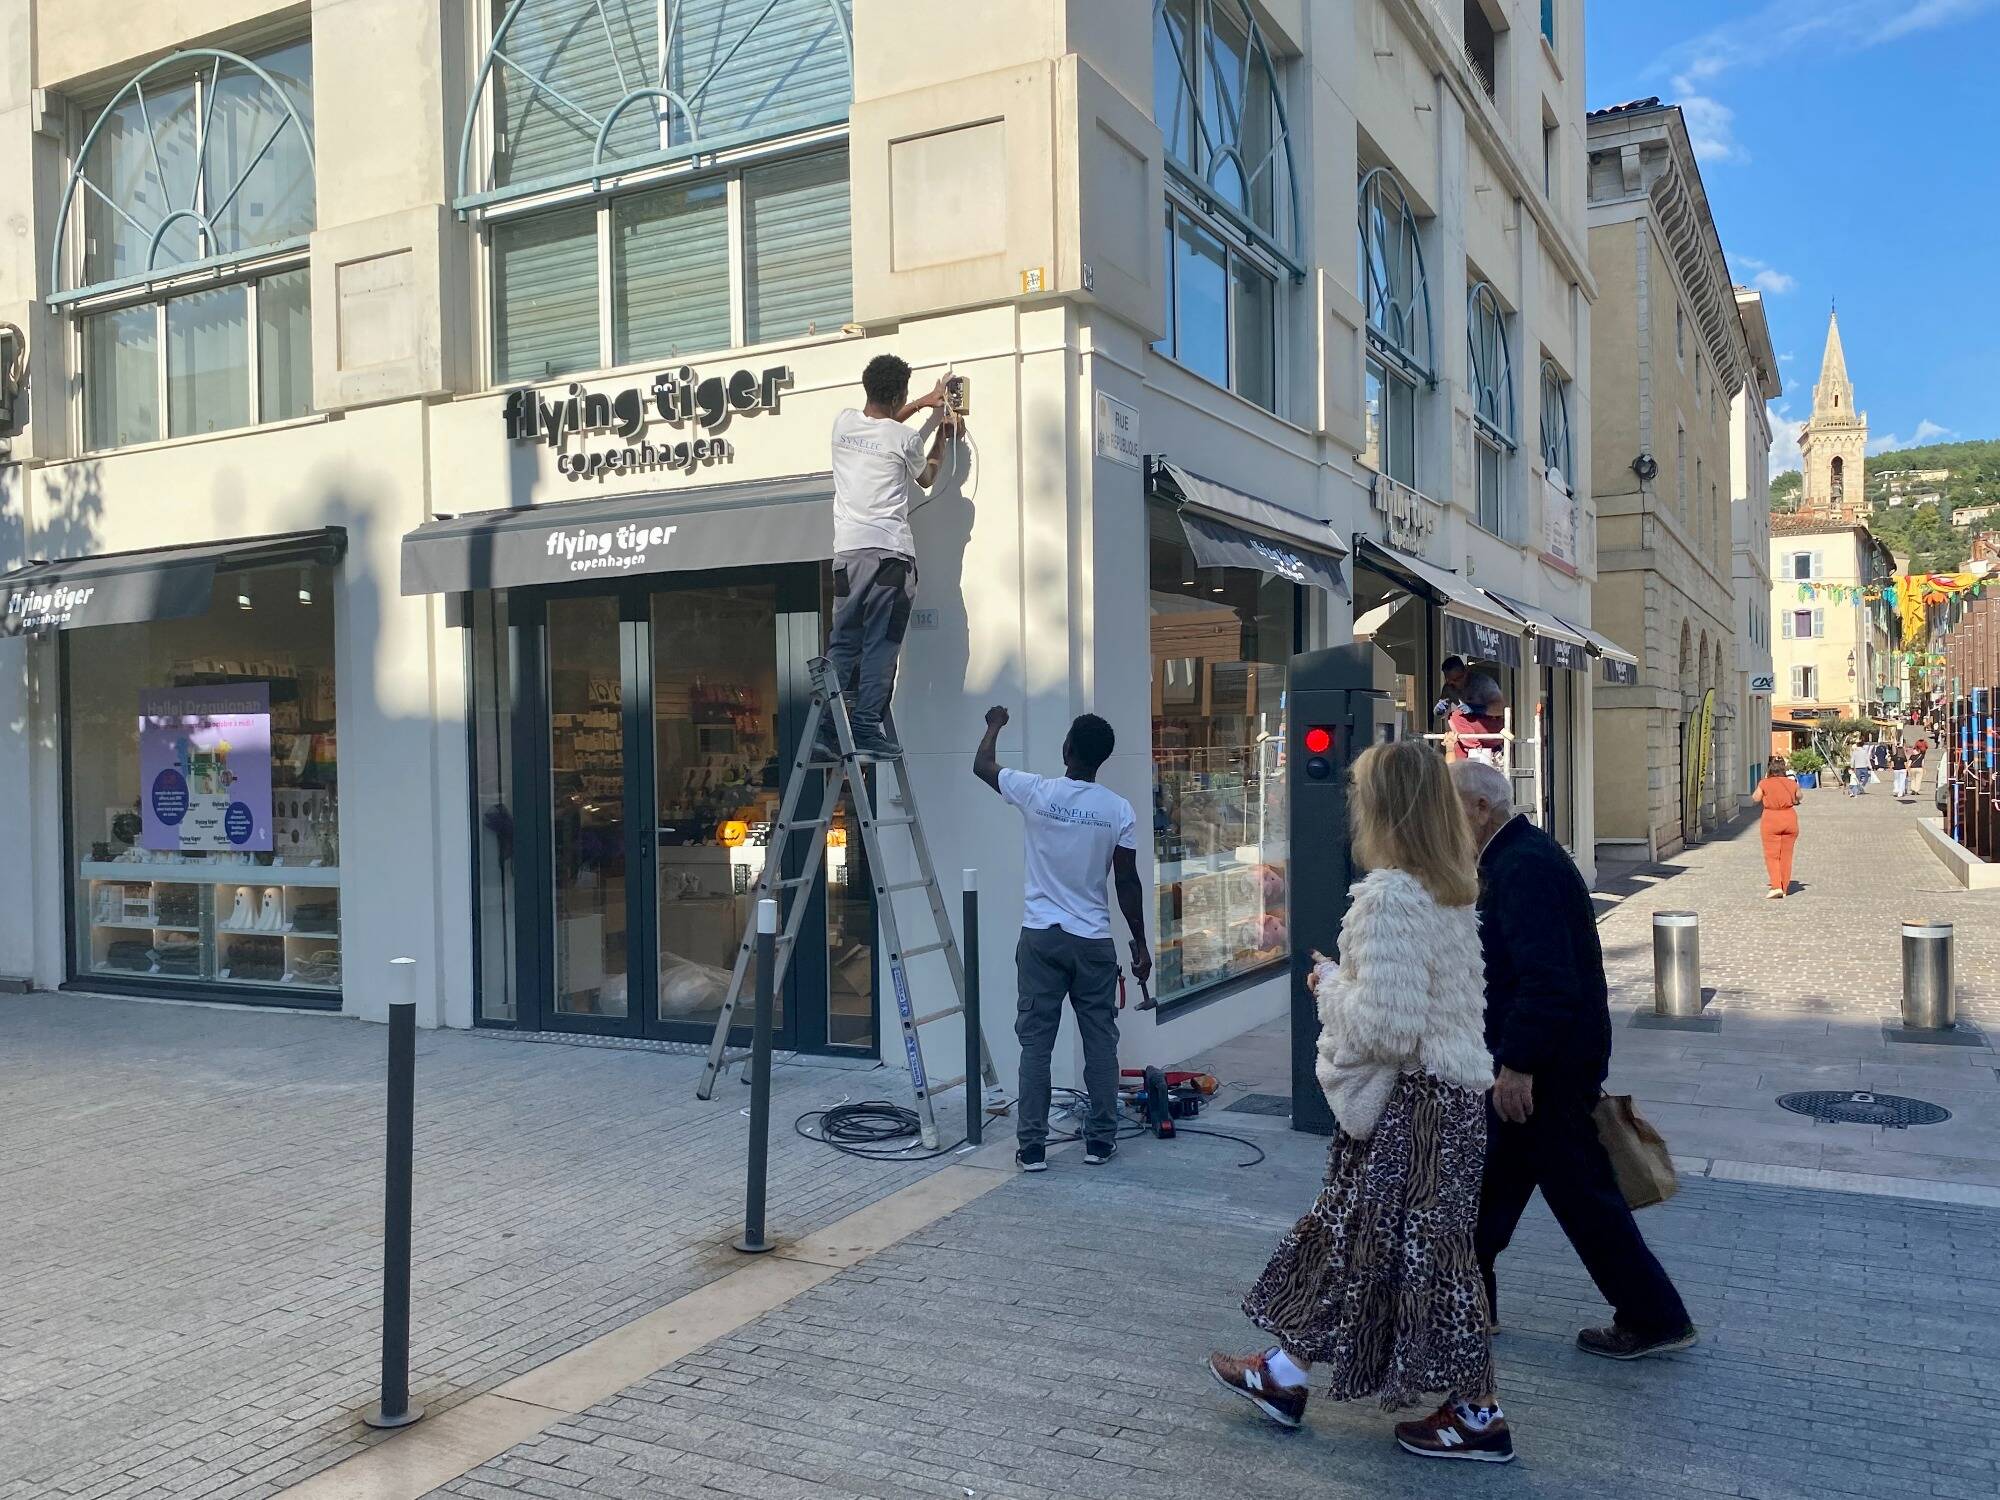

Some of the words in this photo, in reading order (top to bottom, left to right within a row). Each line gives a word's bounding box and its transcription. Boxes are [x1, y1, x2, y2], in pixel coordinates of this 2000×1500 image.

[503, 382, 642, 448] flying
[651, 365, 789, 429] tiger
[1115, 411, 1129, 431] RUE
[558, 437, 729, 476] copenhagen
[546, 529, 612, 560] flying
[616, 523, 677, 553] tiger
[570, 554, 646, 572] copenhagen
[8, 590, 53, 617] flying
[54, 586, 95, 611] tiger
[1244, 1368, 1264, 1391] N
[1436, 1426, 1464, 1447] N
